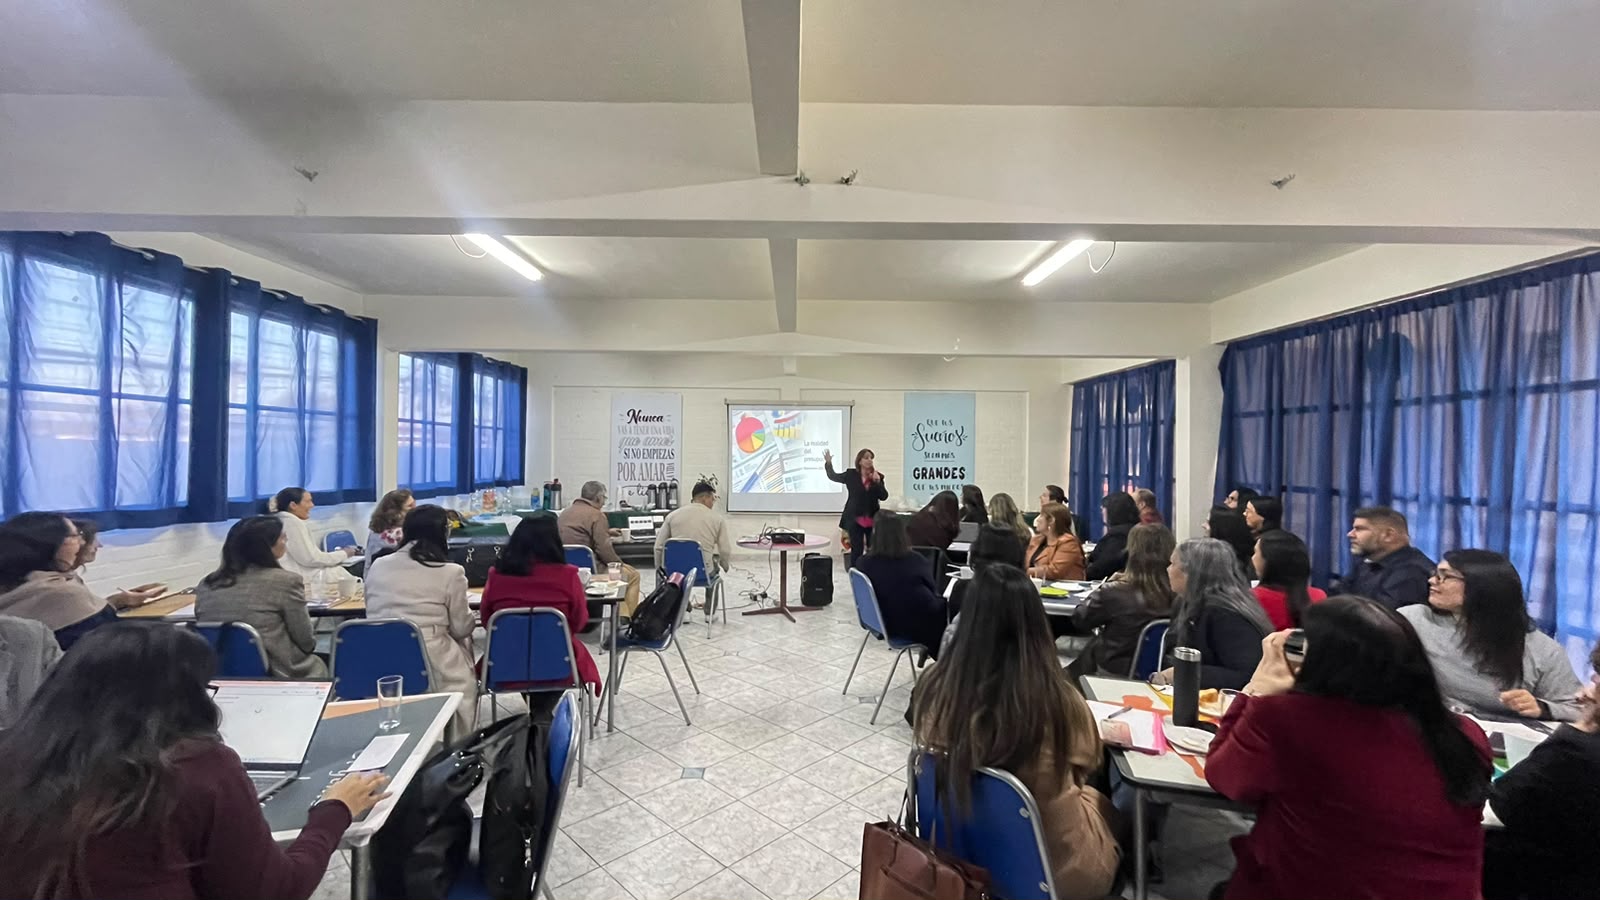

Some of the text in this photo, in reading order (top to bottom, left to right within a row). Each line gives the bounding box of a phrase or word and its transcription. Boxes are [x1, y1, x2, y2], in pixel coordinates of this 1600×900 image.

[626, 408, 664, 424] Nunca
[623, 448, 675, 460] SI NO EMPIEZAS
[617, 462, 666, 481] POR AMAR
[913, 466, 966, 480] GRANDES
